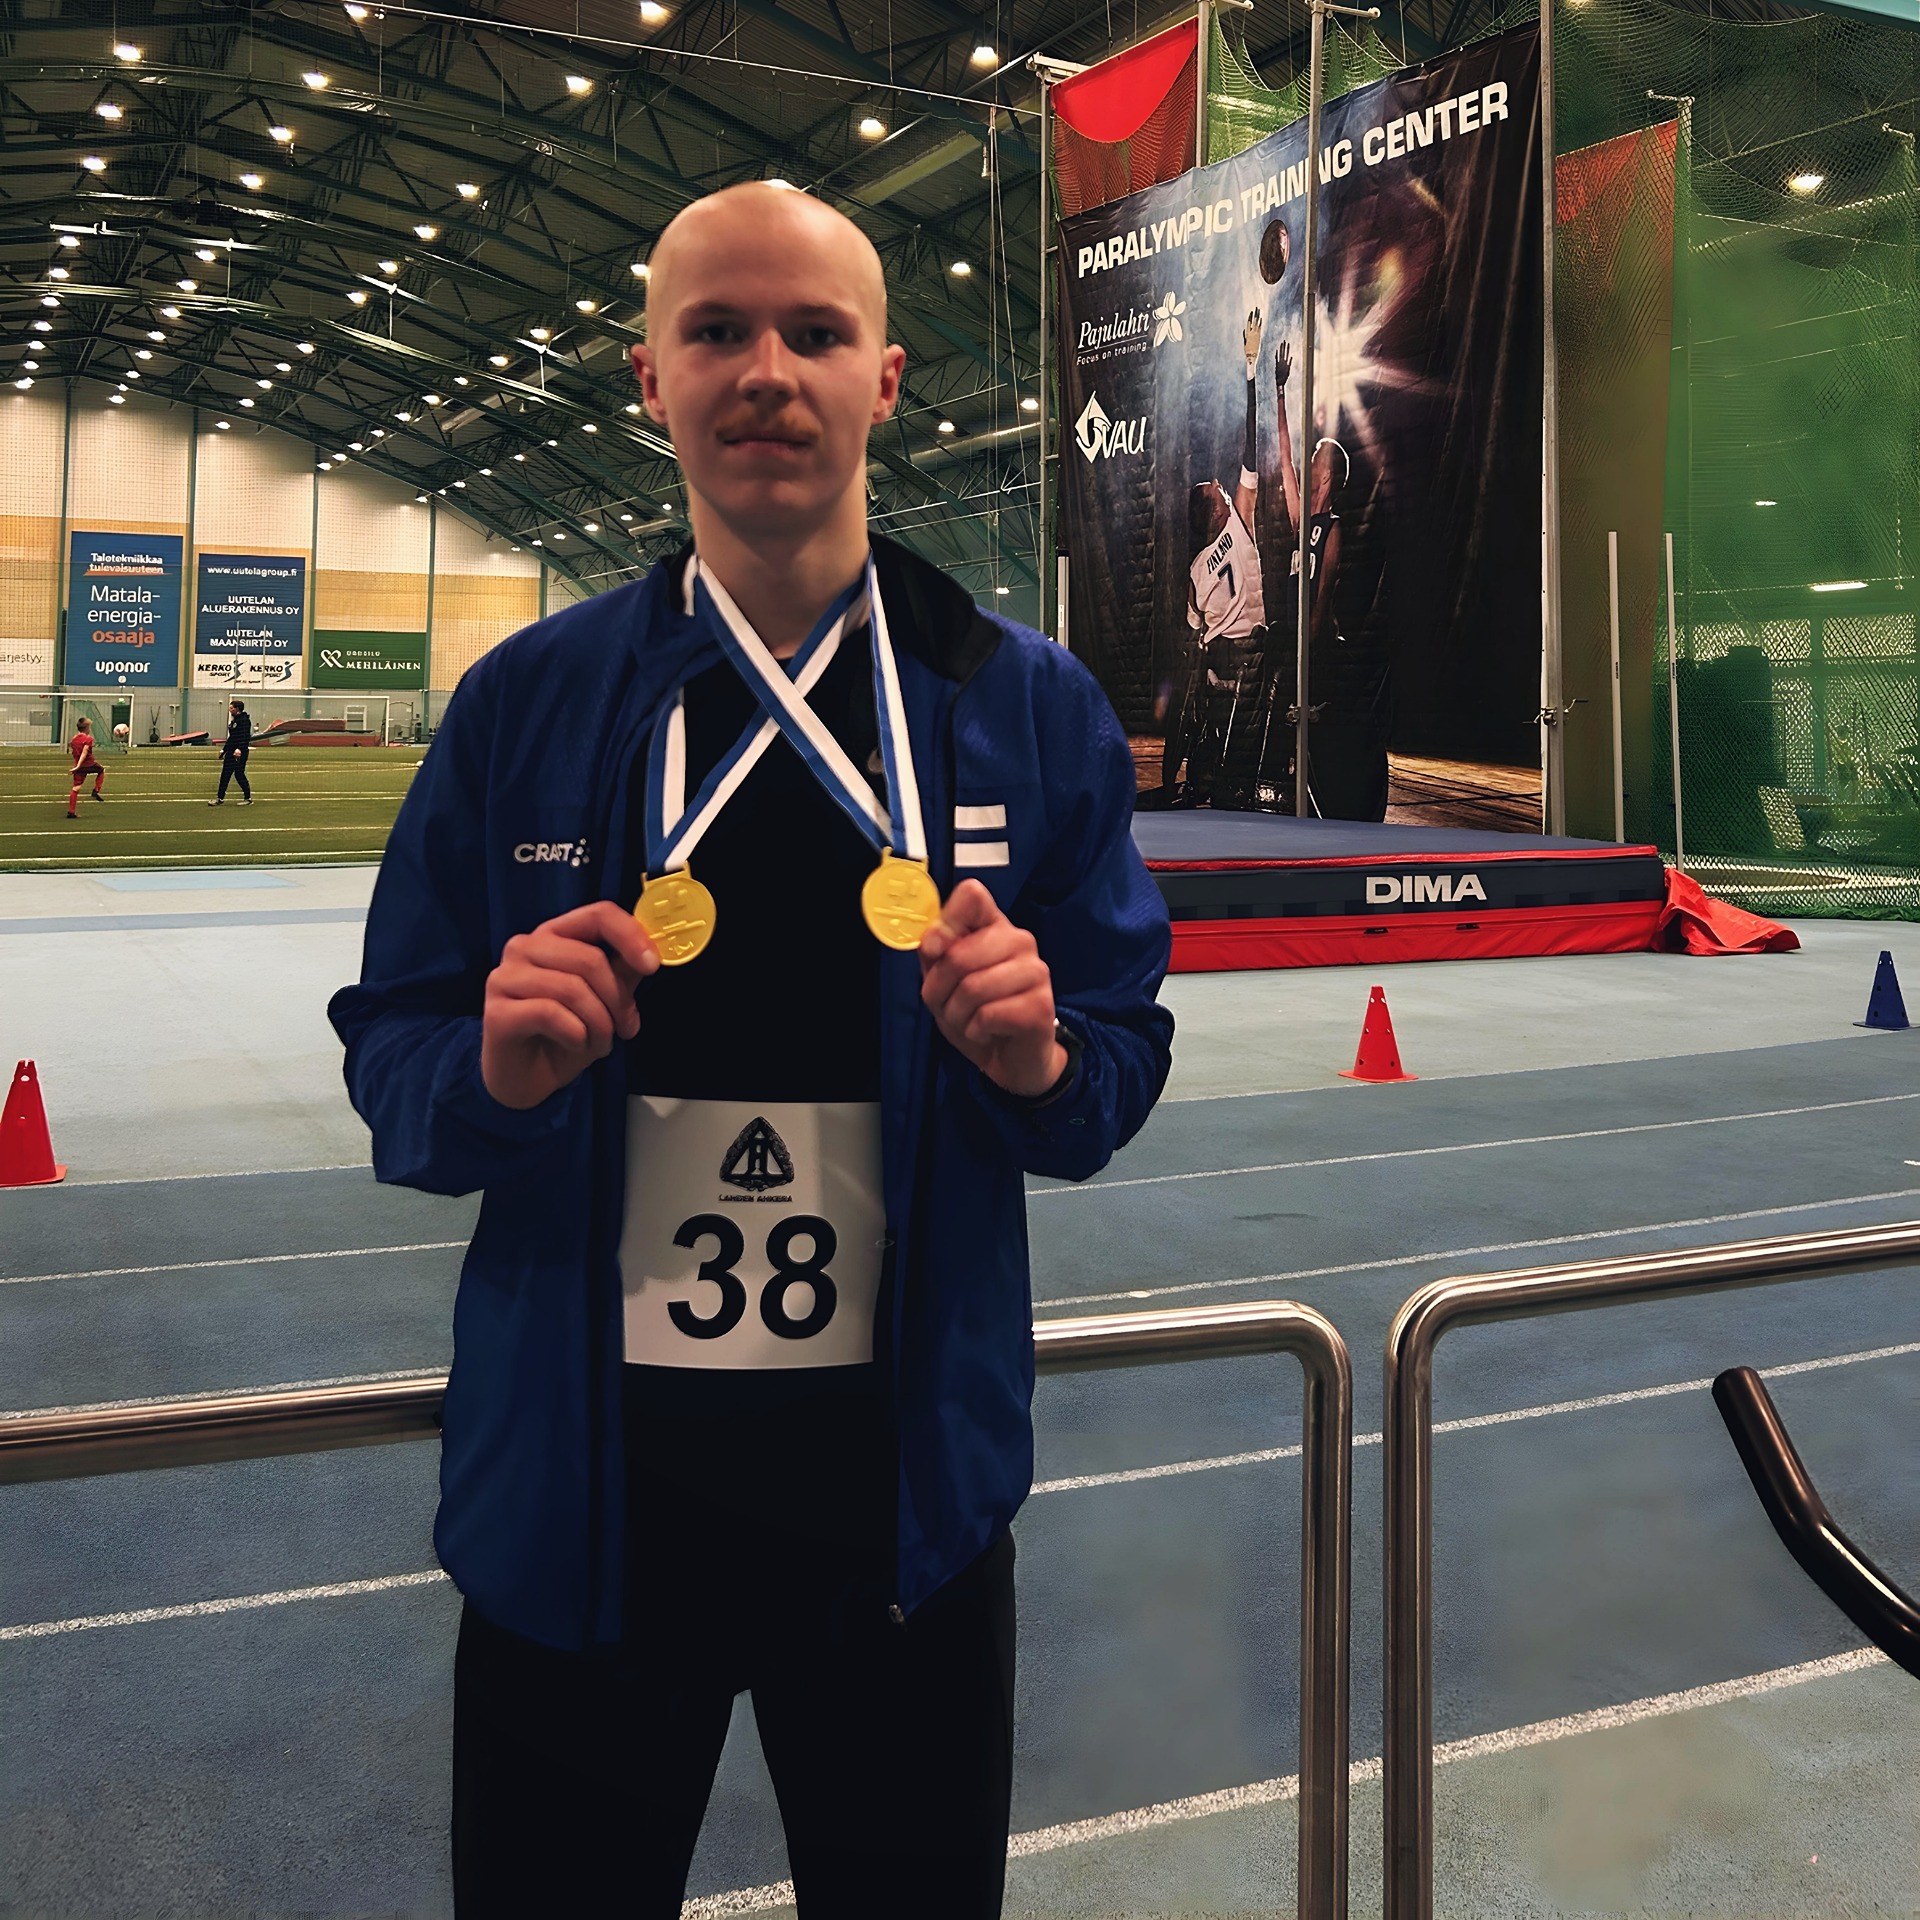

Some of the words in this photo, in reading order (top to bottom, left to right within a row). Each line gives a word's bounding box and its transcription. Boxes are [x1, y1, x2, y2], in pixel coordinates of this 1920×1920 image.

[1078, 199, 1233, 279] PARALYMPIC
[1240, 138, 1353, 223] TRAINING
[1362, 81, 1509, 167] CENTER
[1077, 303, 1150, 350] Pajulahti
[1076, 353, 1100, 366] Focus
[1102, 350, 1112, 360] on
[1114, 341, 1147, 357] training
[90, 552, 163, 565] Talotekniikkaa
[89, 563, 163, 574] tulevaisuuteen
[1217, 562, 1237, 600] 7
[90, 584, 161, 604] Matala-
[227, 595, 275, 605] UUTELAN
[87, 607, 161, 628] energia-
[201, 604, 283, 615] ALUERAKENNUS
[285, 606, 300, 615] OY
[92, 627, 155, 648] osaaja
[226, 629, 273, 638] UUTELAN
[273, 639, 289, 648] OY
[95, 661, 151, 675] uponor
[198, 663, 232, 672] KERKO
[345, 660, 421, 671] MEHILÄINEN
[1366, 873, 1488, 904] DIMA
[666, 1212, 838, 1340] 38
